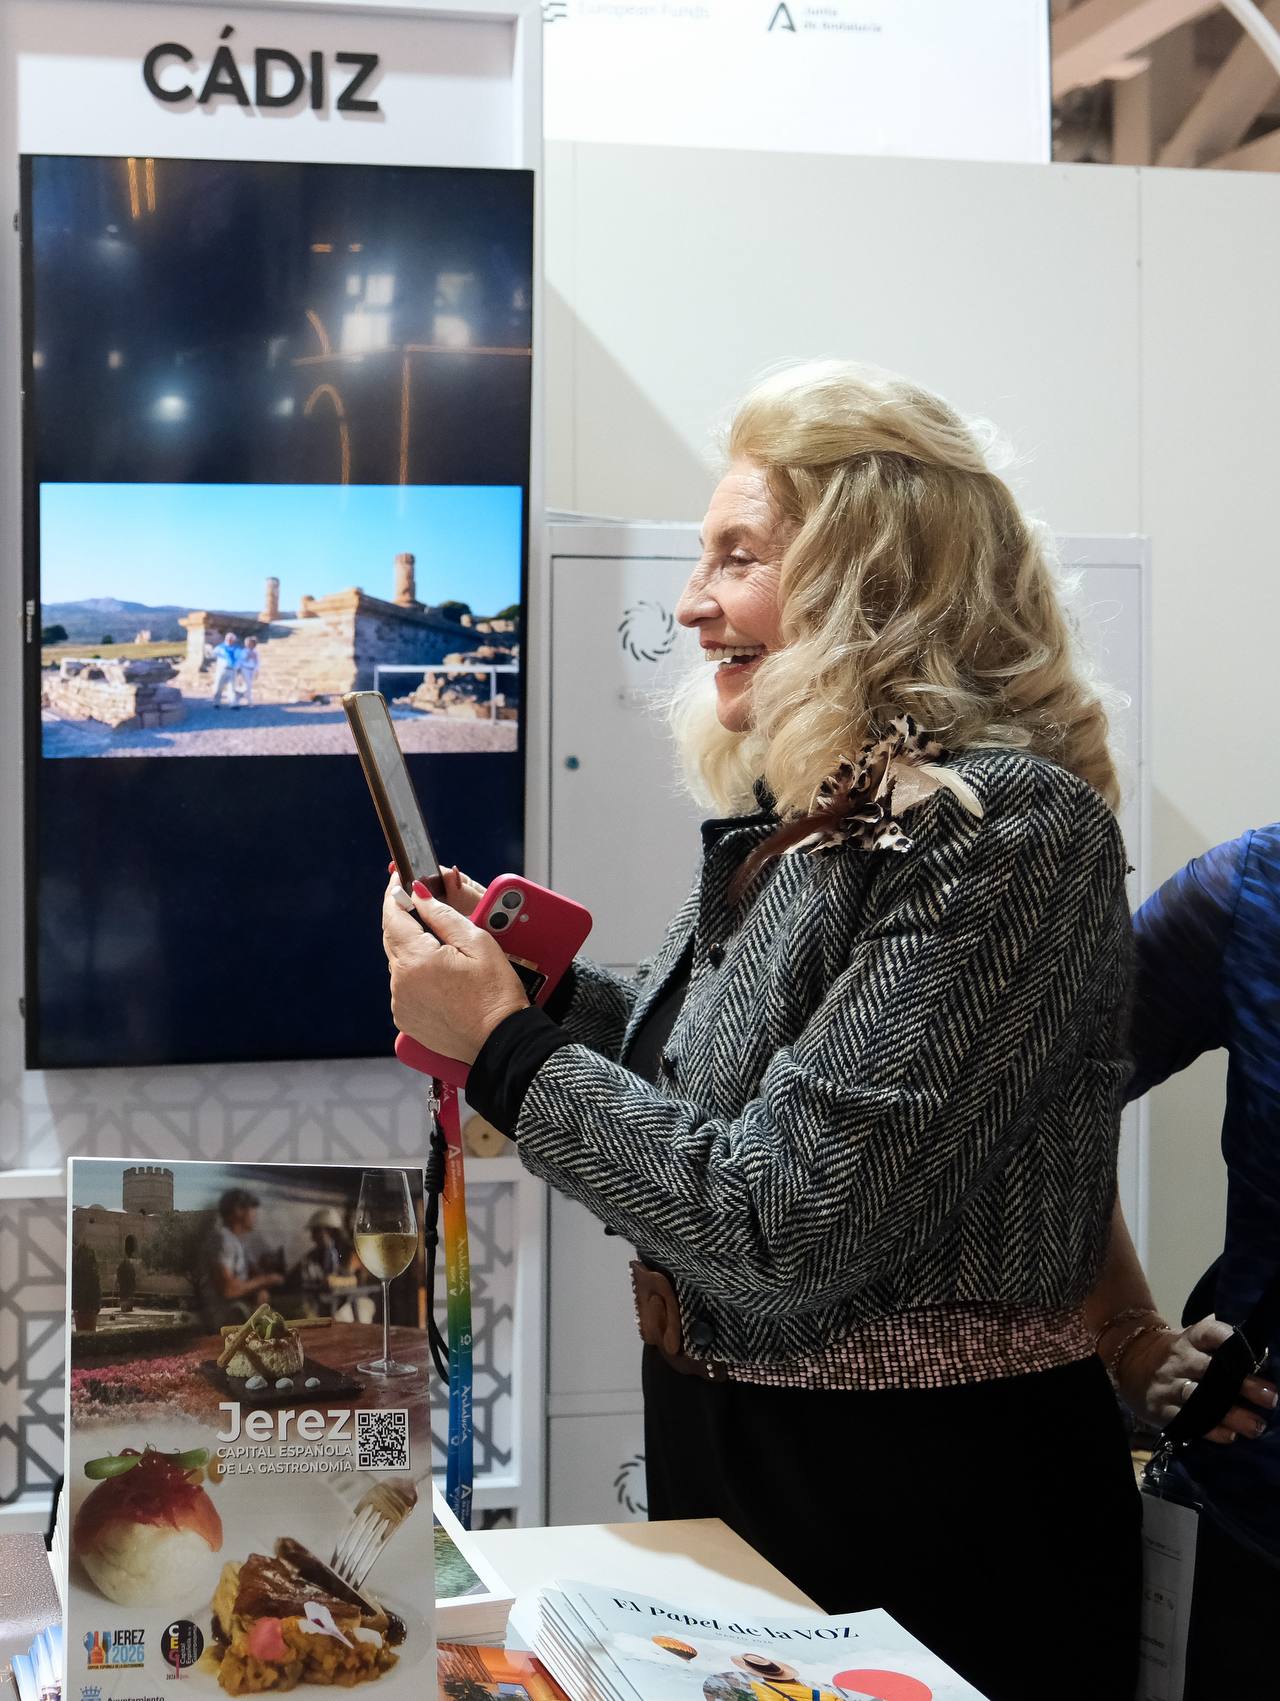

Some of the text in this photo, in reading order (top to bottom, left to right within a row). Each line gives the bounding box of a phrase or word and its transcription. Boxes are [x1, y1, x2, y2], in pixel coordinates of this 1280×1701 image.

[142, 24, 380, 112] CÁDIZ
[216, 1401, 353, 1443] Jerez
[216, 1443, 354, 1459] CAPITAL ESPAÑOLA
[216, 1459, 354, 1475] DE LA GASTRONOMÍA
[610, 1596, 860, 1641] El Papel de la VOZ
[112, 1629, 145, 1646] JEREZ
[111, 1645, 145, 1664] 2026
